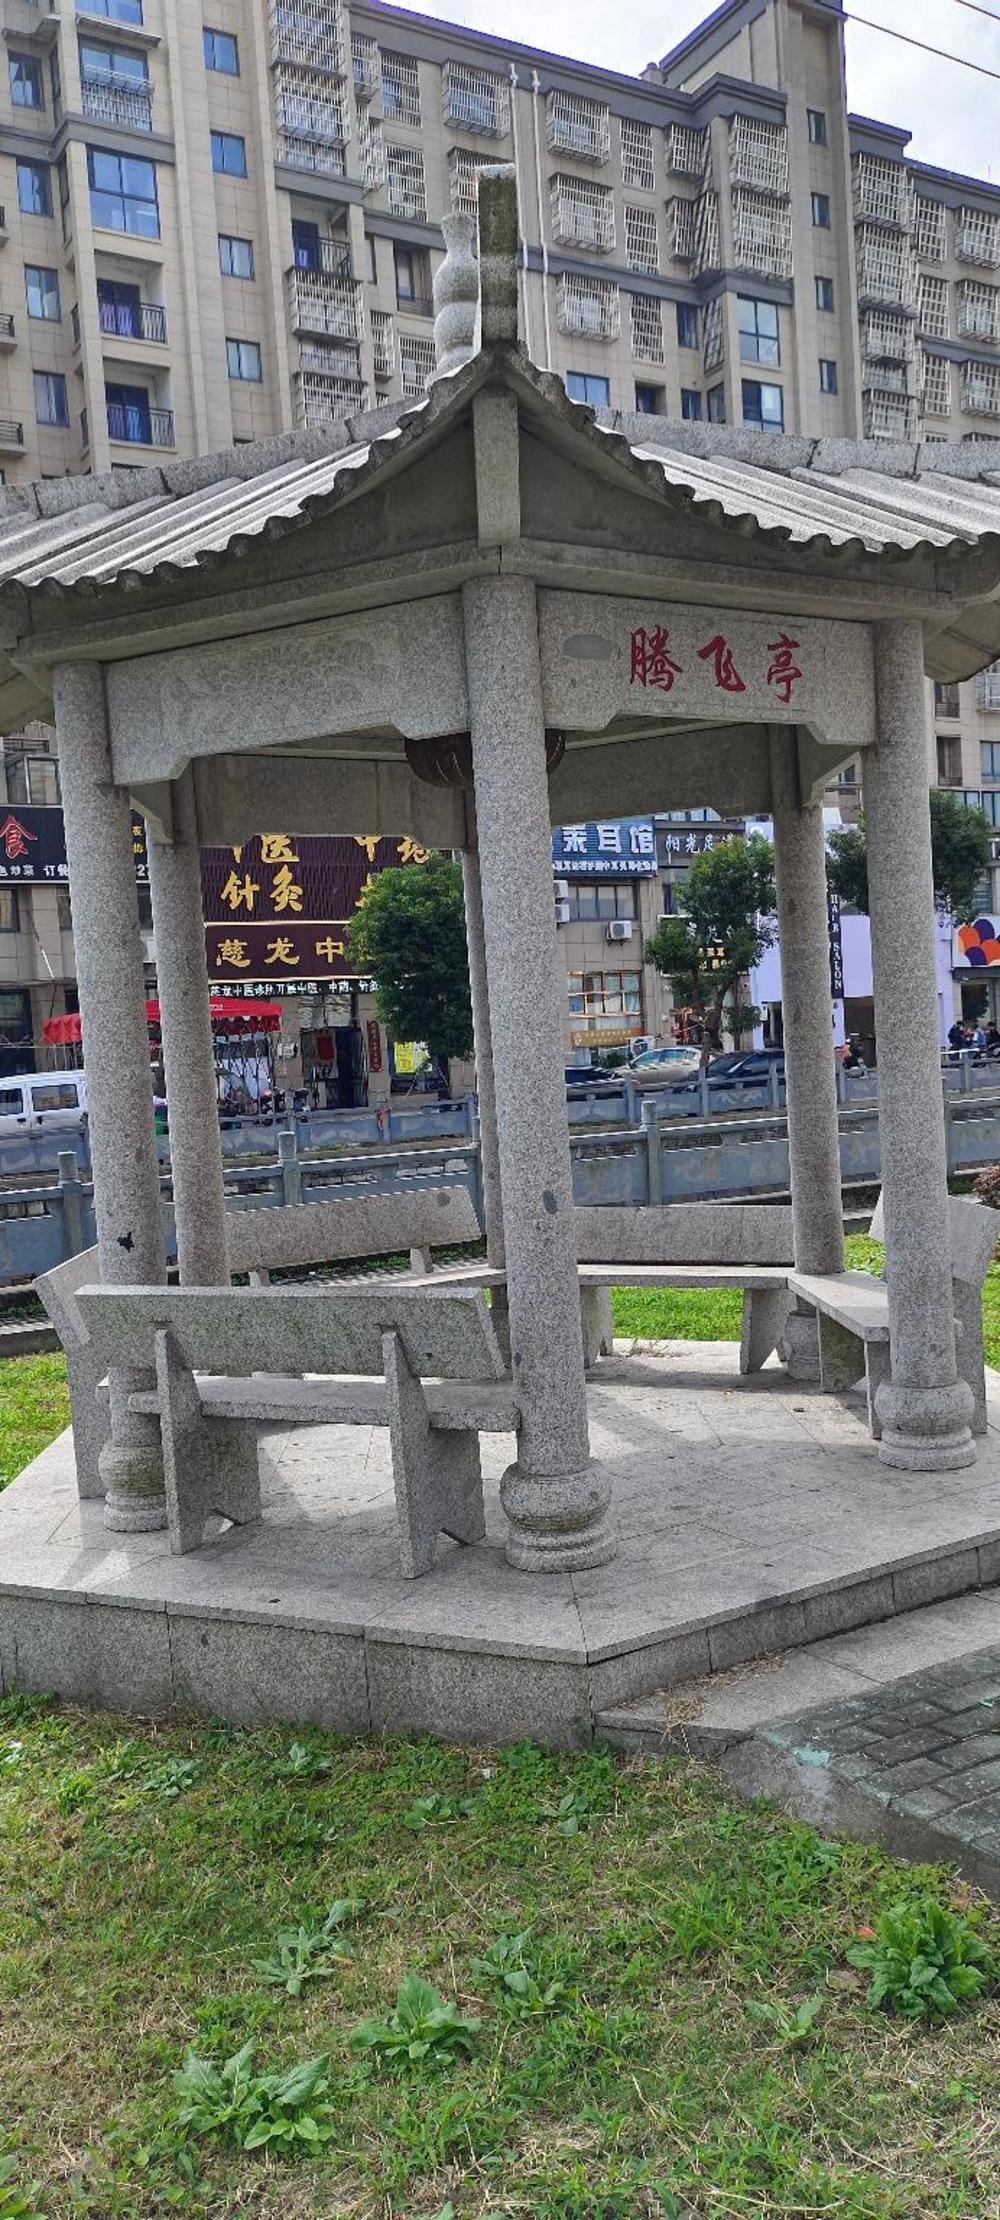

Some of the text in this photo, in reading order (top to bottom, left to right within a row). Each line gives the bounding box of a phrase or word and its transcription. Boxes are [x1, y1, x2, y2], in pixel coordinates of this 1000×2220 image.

[629, 624, 803, 704] 腾飞亭
[0, 815, 38, 859] 食
[221, 864, 303, 912] 针灸
[216, 936, 345, 968] 慈龙中
[830, 894, 842, 990] HAIR SALON
